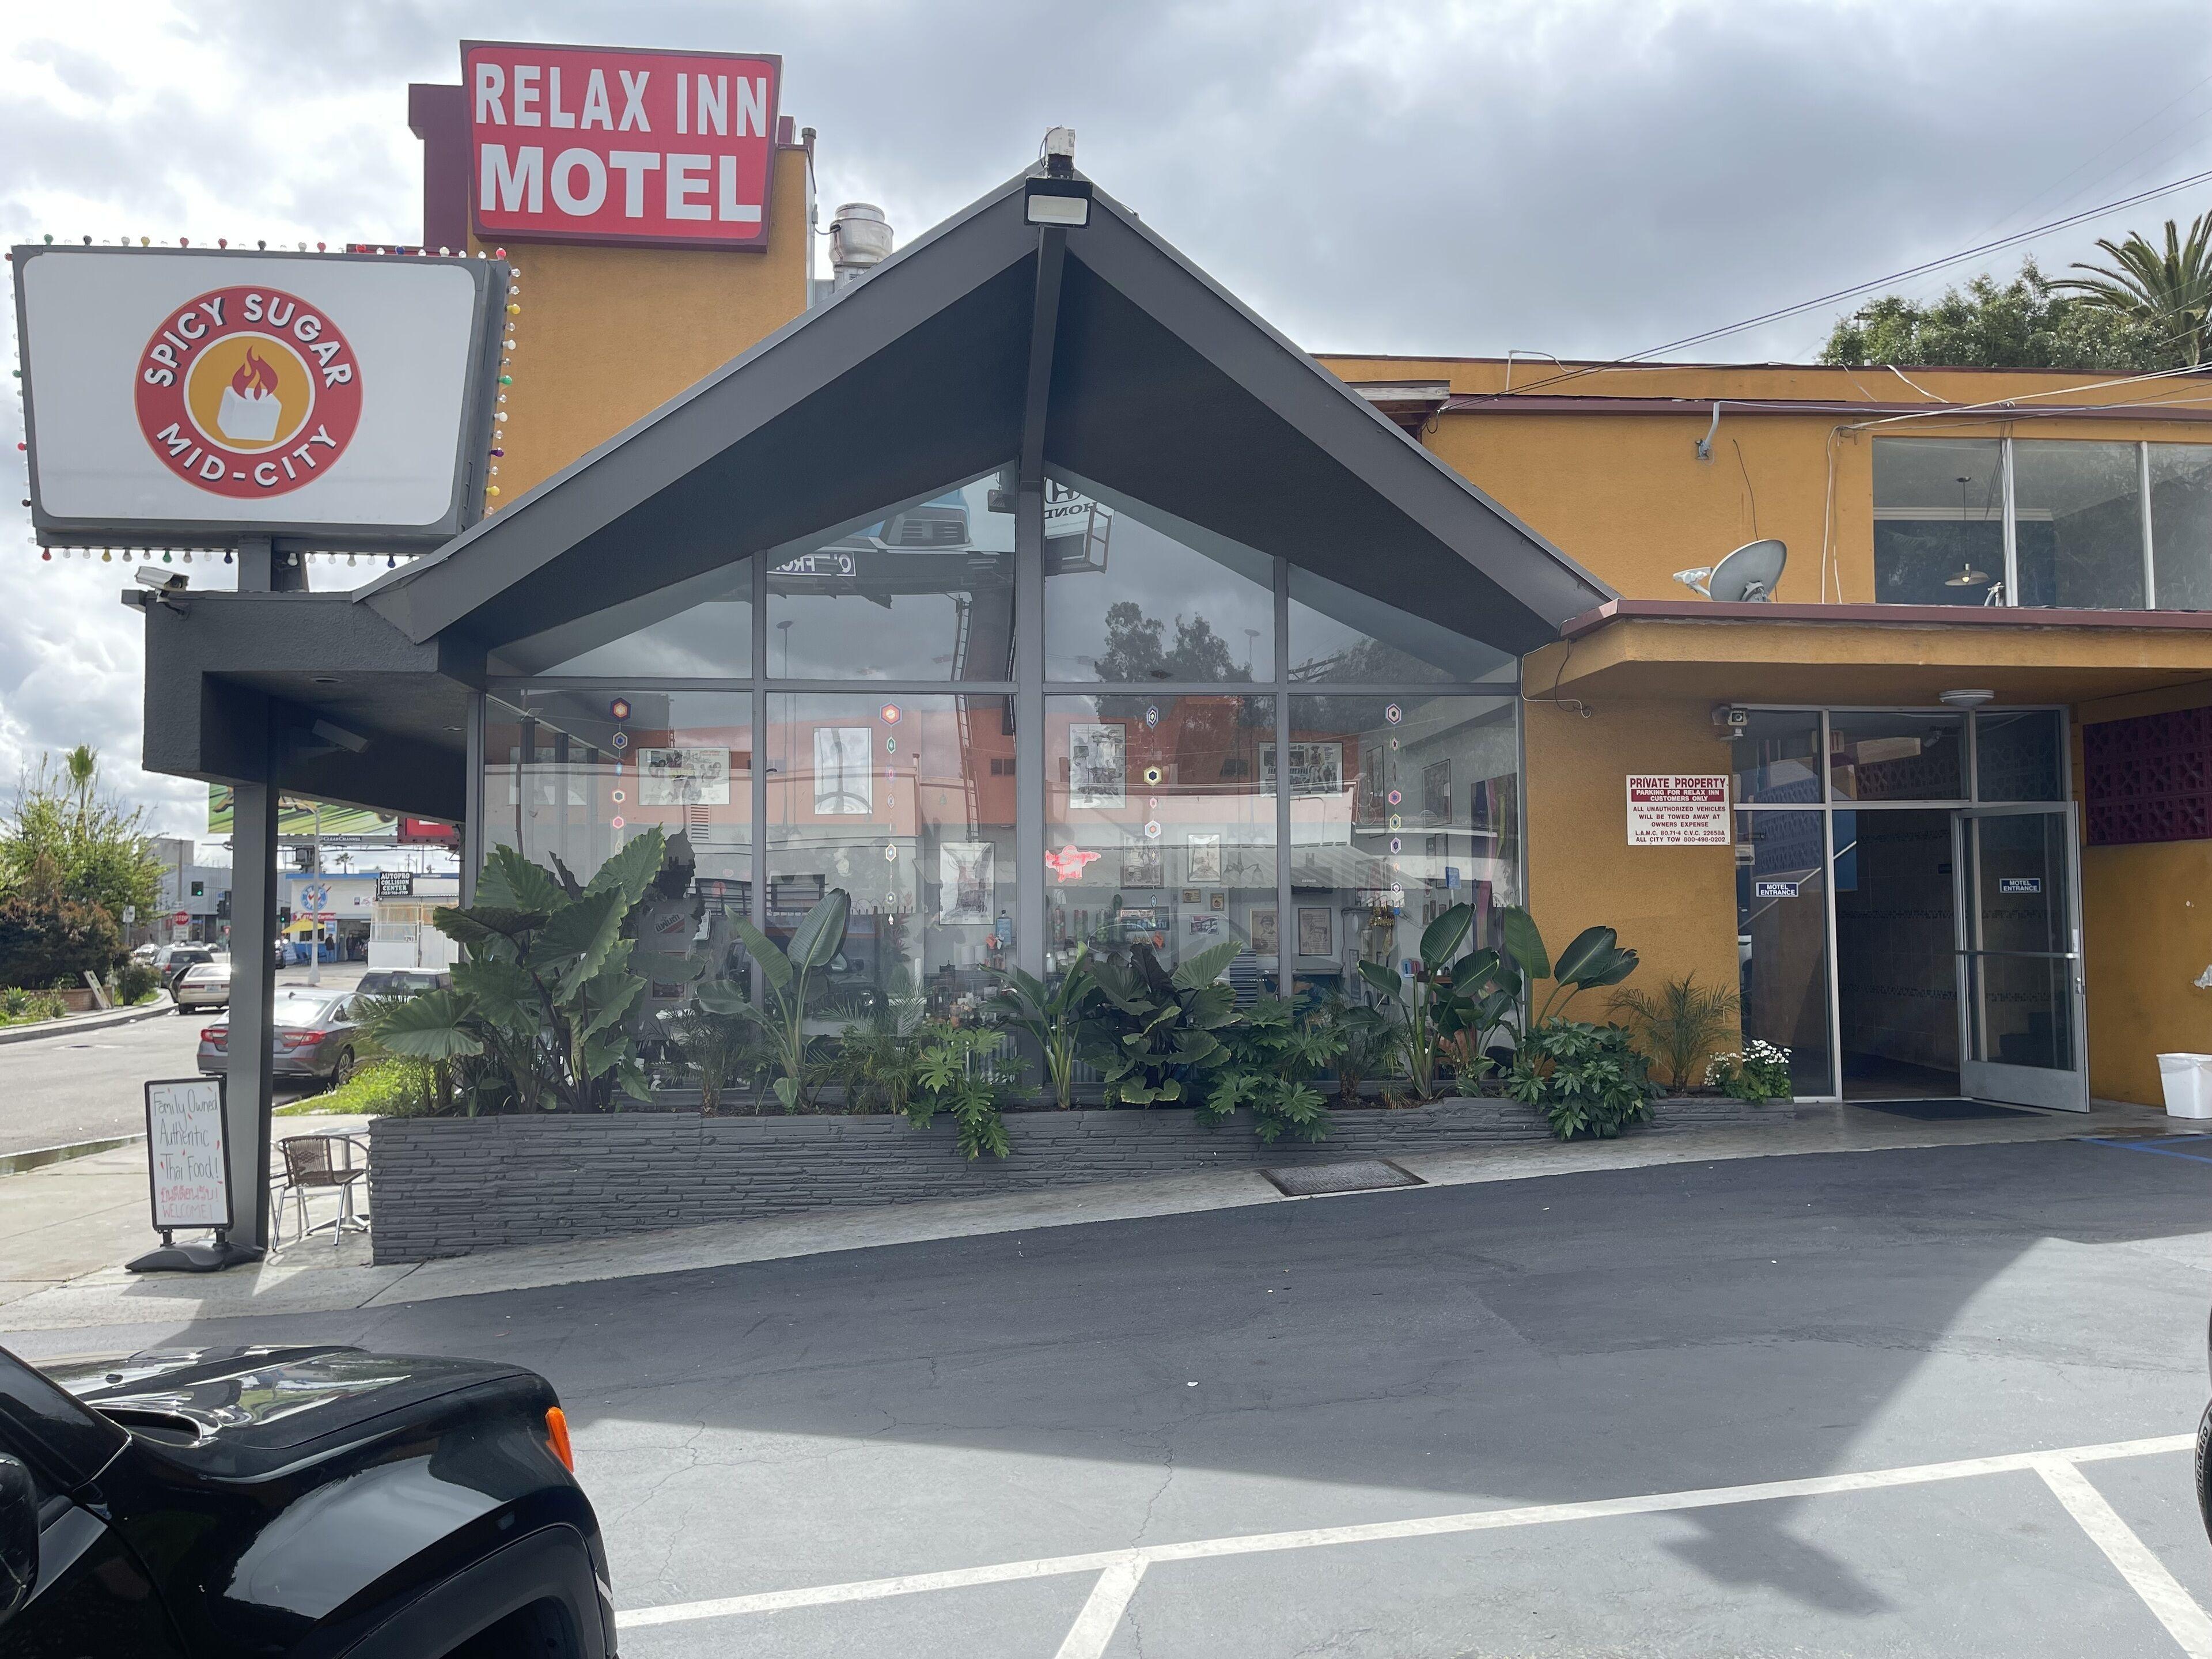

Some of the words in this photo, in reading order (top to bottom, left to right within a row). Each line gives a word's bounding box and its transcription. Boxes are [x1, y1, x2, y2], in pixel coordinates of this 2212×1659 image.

[475, 62, 652, 132] RELAX
[676, 73, 767, 138] INN
[479, 143, 762, 222] MOTEL
[143, 297, 226, 388] SPICY
[243, 293, 353, 388] SUGAR
[156, 423, 337, 486] MID-CITY
[1630, 777, 1669, 788] PRIVATE
[1675, 778, 1726, 788] PROPERTY
[153, 1091, 187, 1132] Family
[187, 1089, 218, 1114] Owned
[160, 1118, 210, 1147] Authentic
[160, 1153, 183, 1180] Thai
[187, 1155, 219, 1181] Food!
[162, 1203, 213, 1219] WELCOME!
